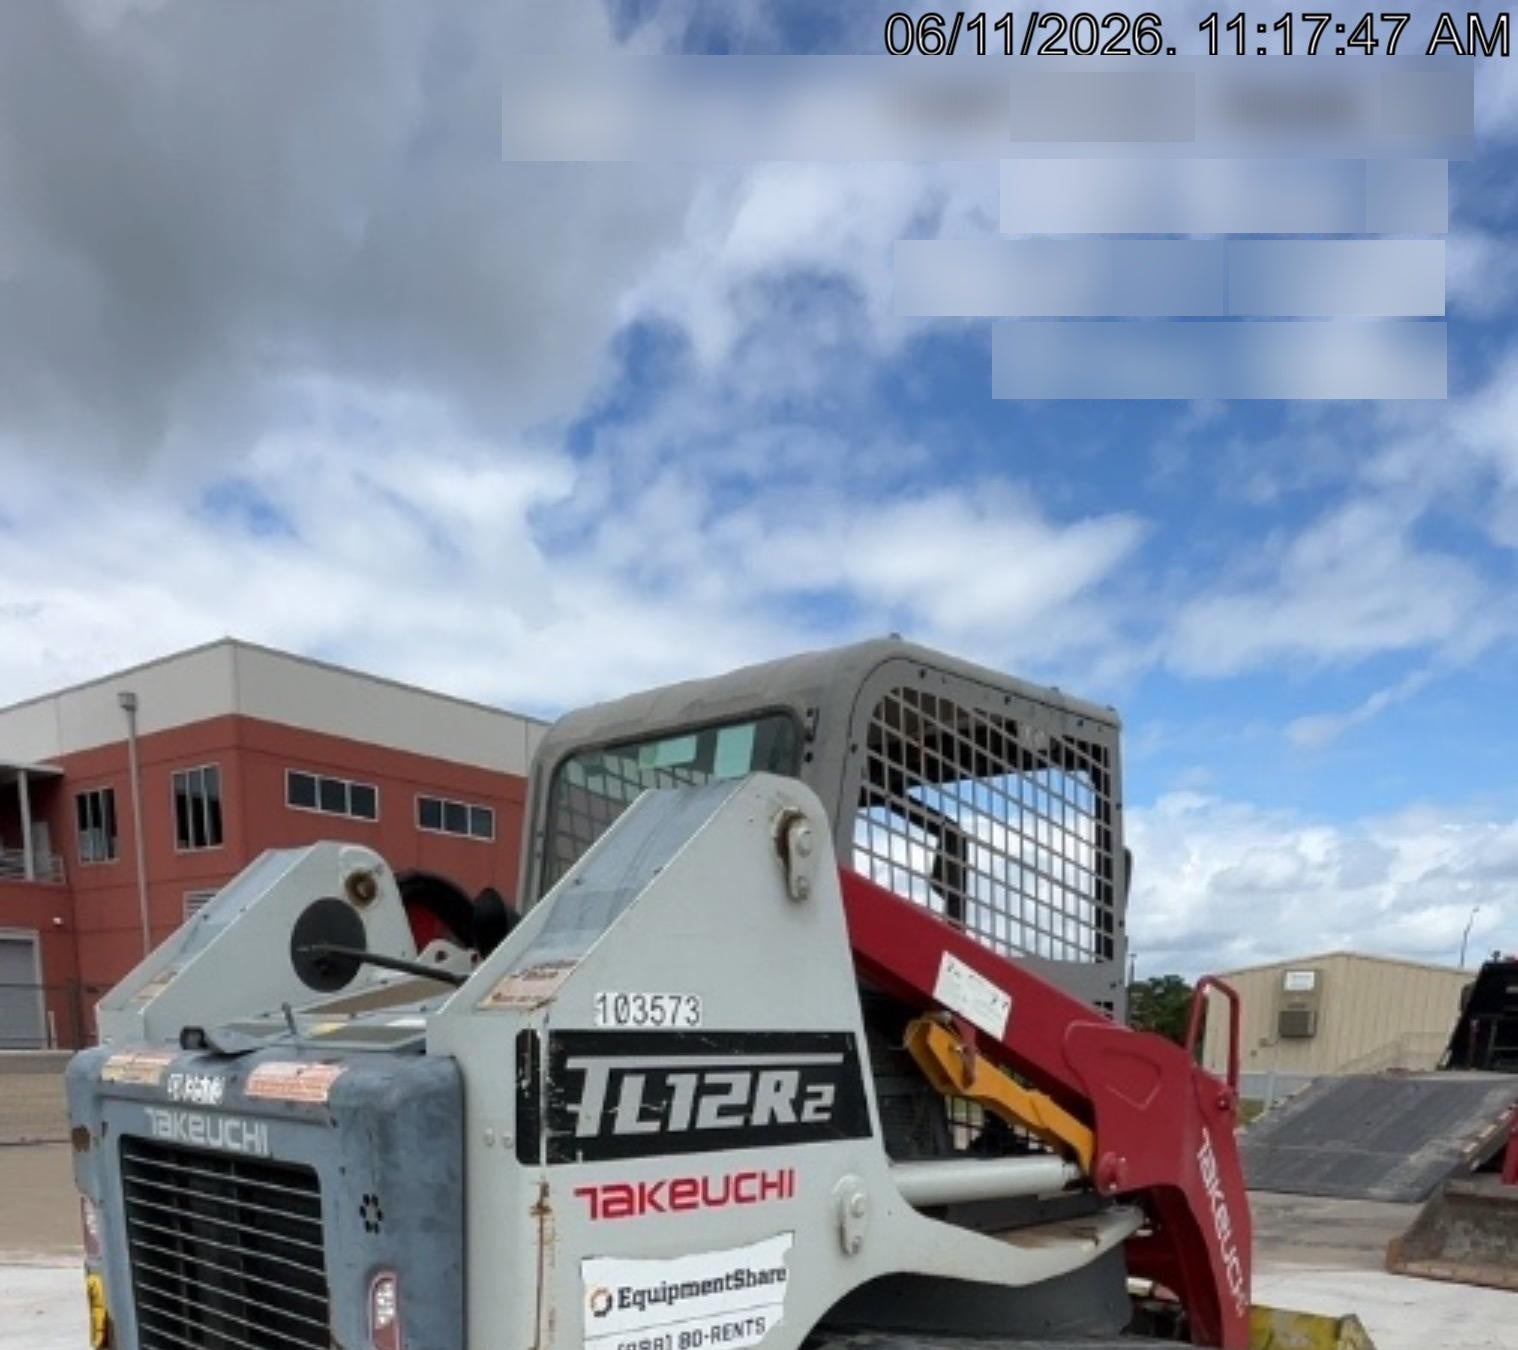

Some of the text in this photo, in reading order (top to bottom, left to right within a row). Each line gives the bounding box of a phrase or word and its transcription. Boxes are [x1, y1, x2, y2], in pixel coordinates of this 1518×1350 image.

[597, 993, 700, 1025] 103573
[566, 1053, 844, 1138] TL12R2
[574, 1168, 795, 1221] TAKEUCHI
[617, 1267, 788, 1311] EquipmentShare
[678, 1316, 767, 1350] 80-RENTS
